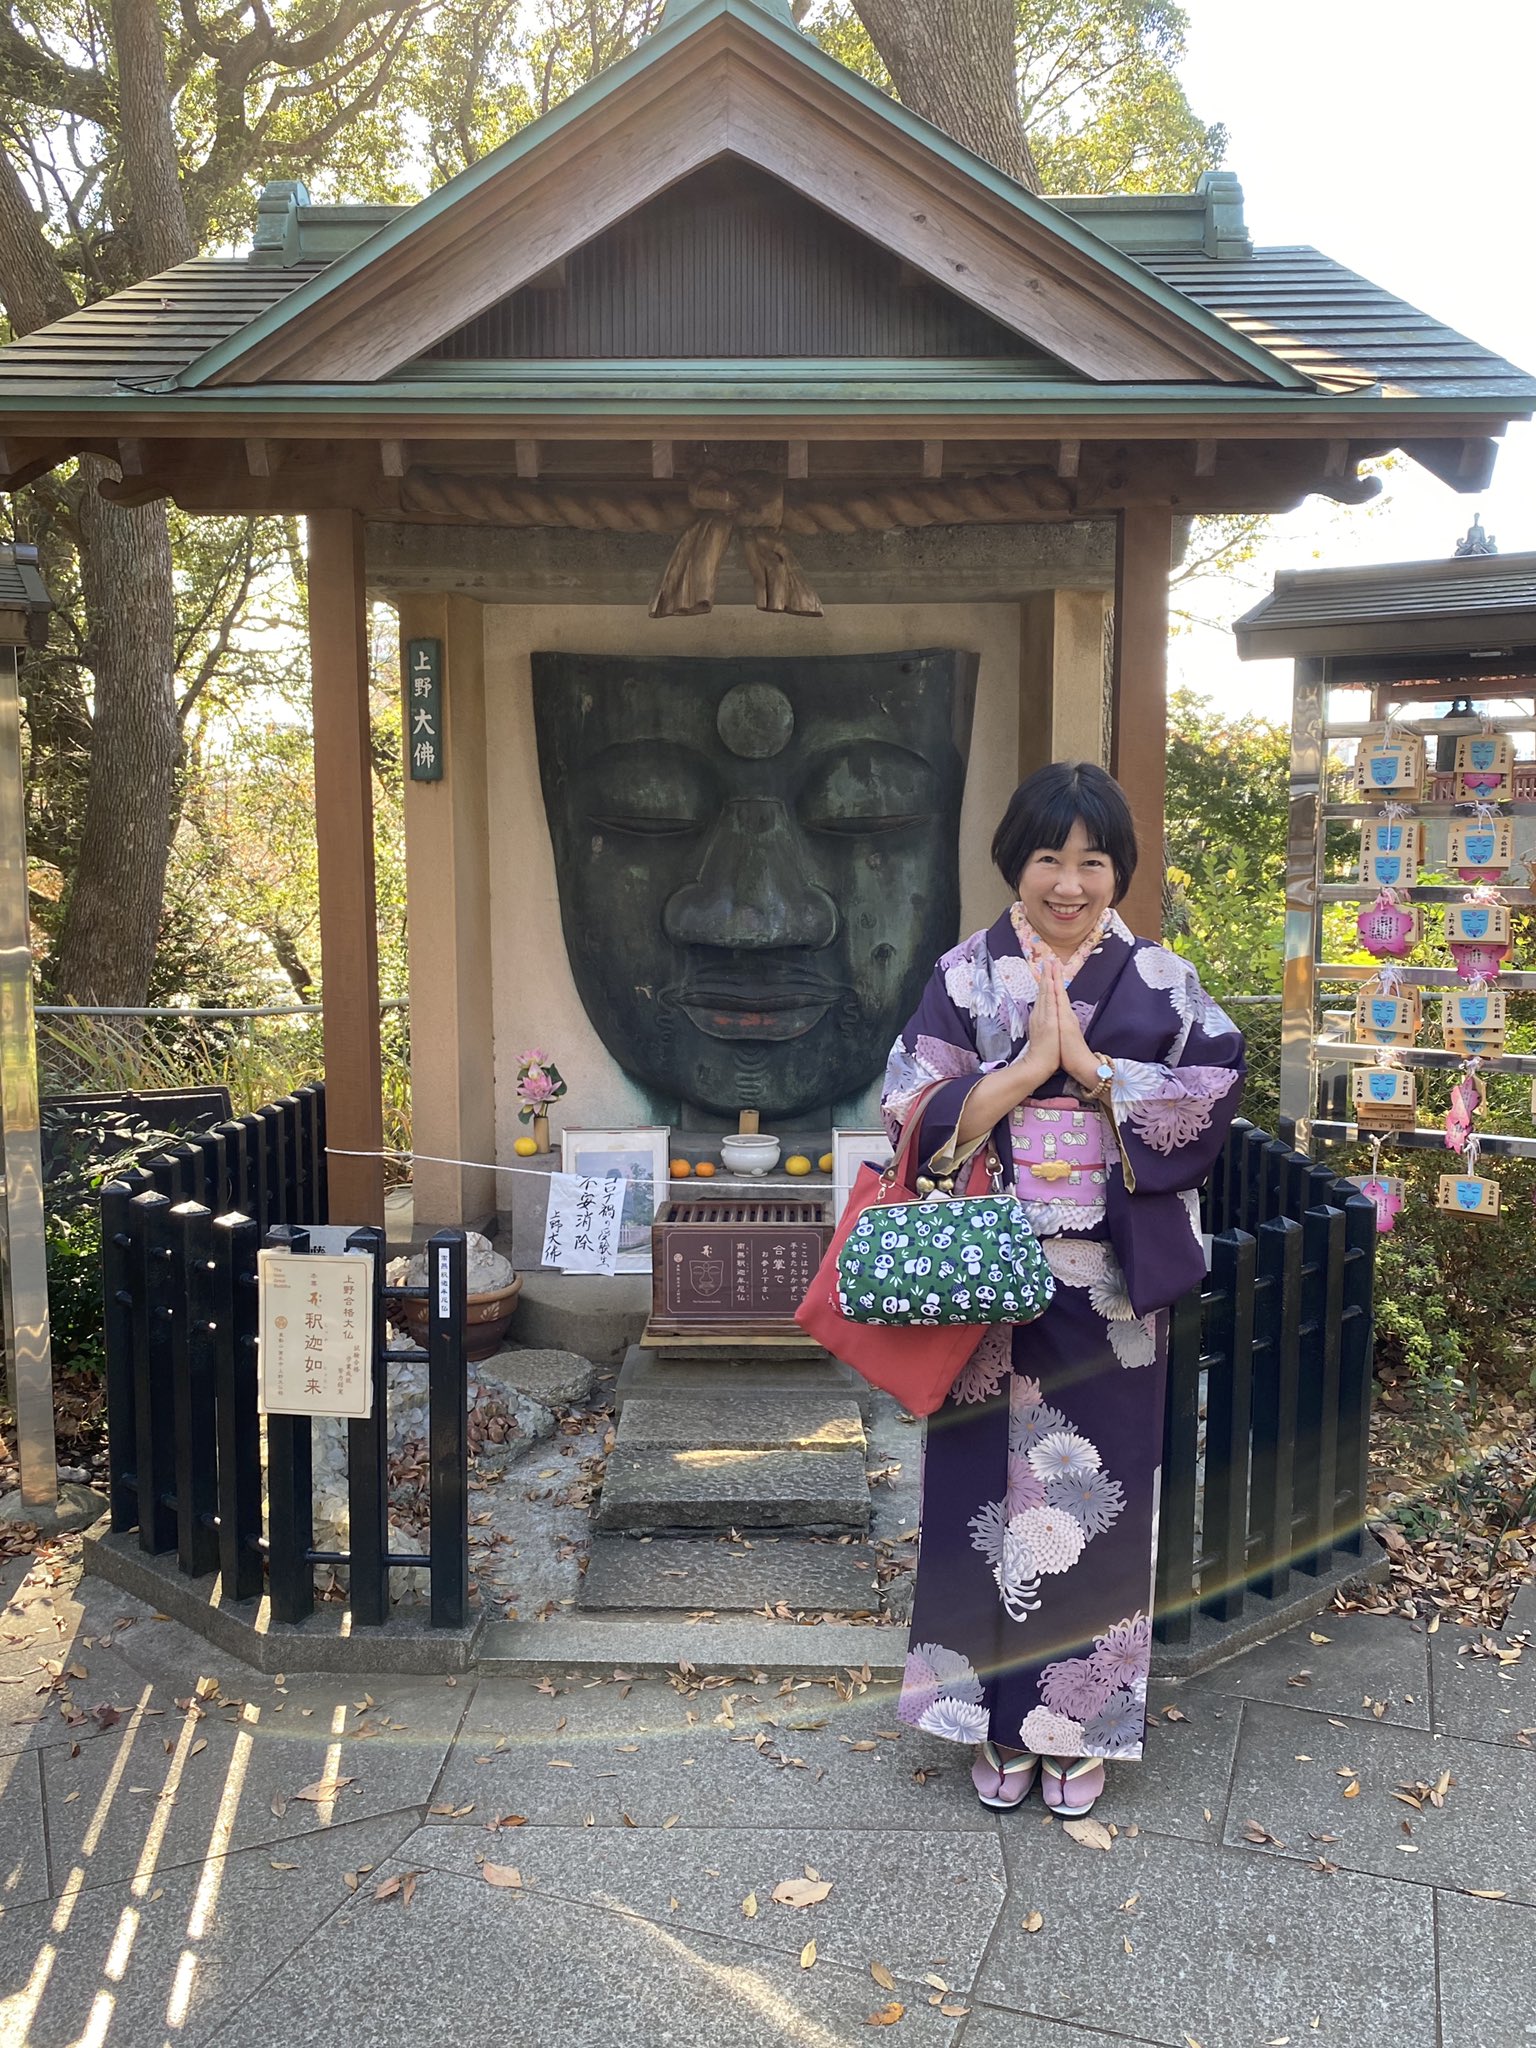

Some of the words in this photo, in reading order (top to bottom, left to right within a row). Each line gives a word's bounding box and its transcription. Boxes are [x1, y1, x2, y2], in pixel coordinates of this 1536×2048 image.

[412, 650, 436, 769] 上野大佛
[574, 1175, 598, 1252] 不安消除
[736, 1242, 746, 1301] 南無釈迦牟尼仏
[761, 1251, 769, 1301] お参り下さい
[772, 1244, 786, 1284] 合掌で
[790, 1241, 798, 1301] 手をたたかずに
[800, 1242, 809, 1299] ここはお寺で
[343, 1275, 355, 1340] 上野合格大仏
[303, 1312, 323, 1395] 釈迦如来
